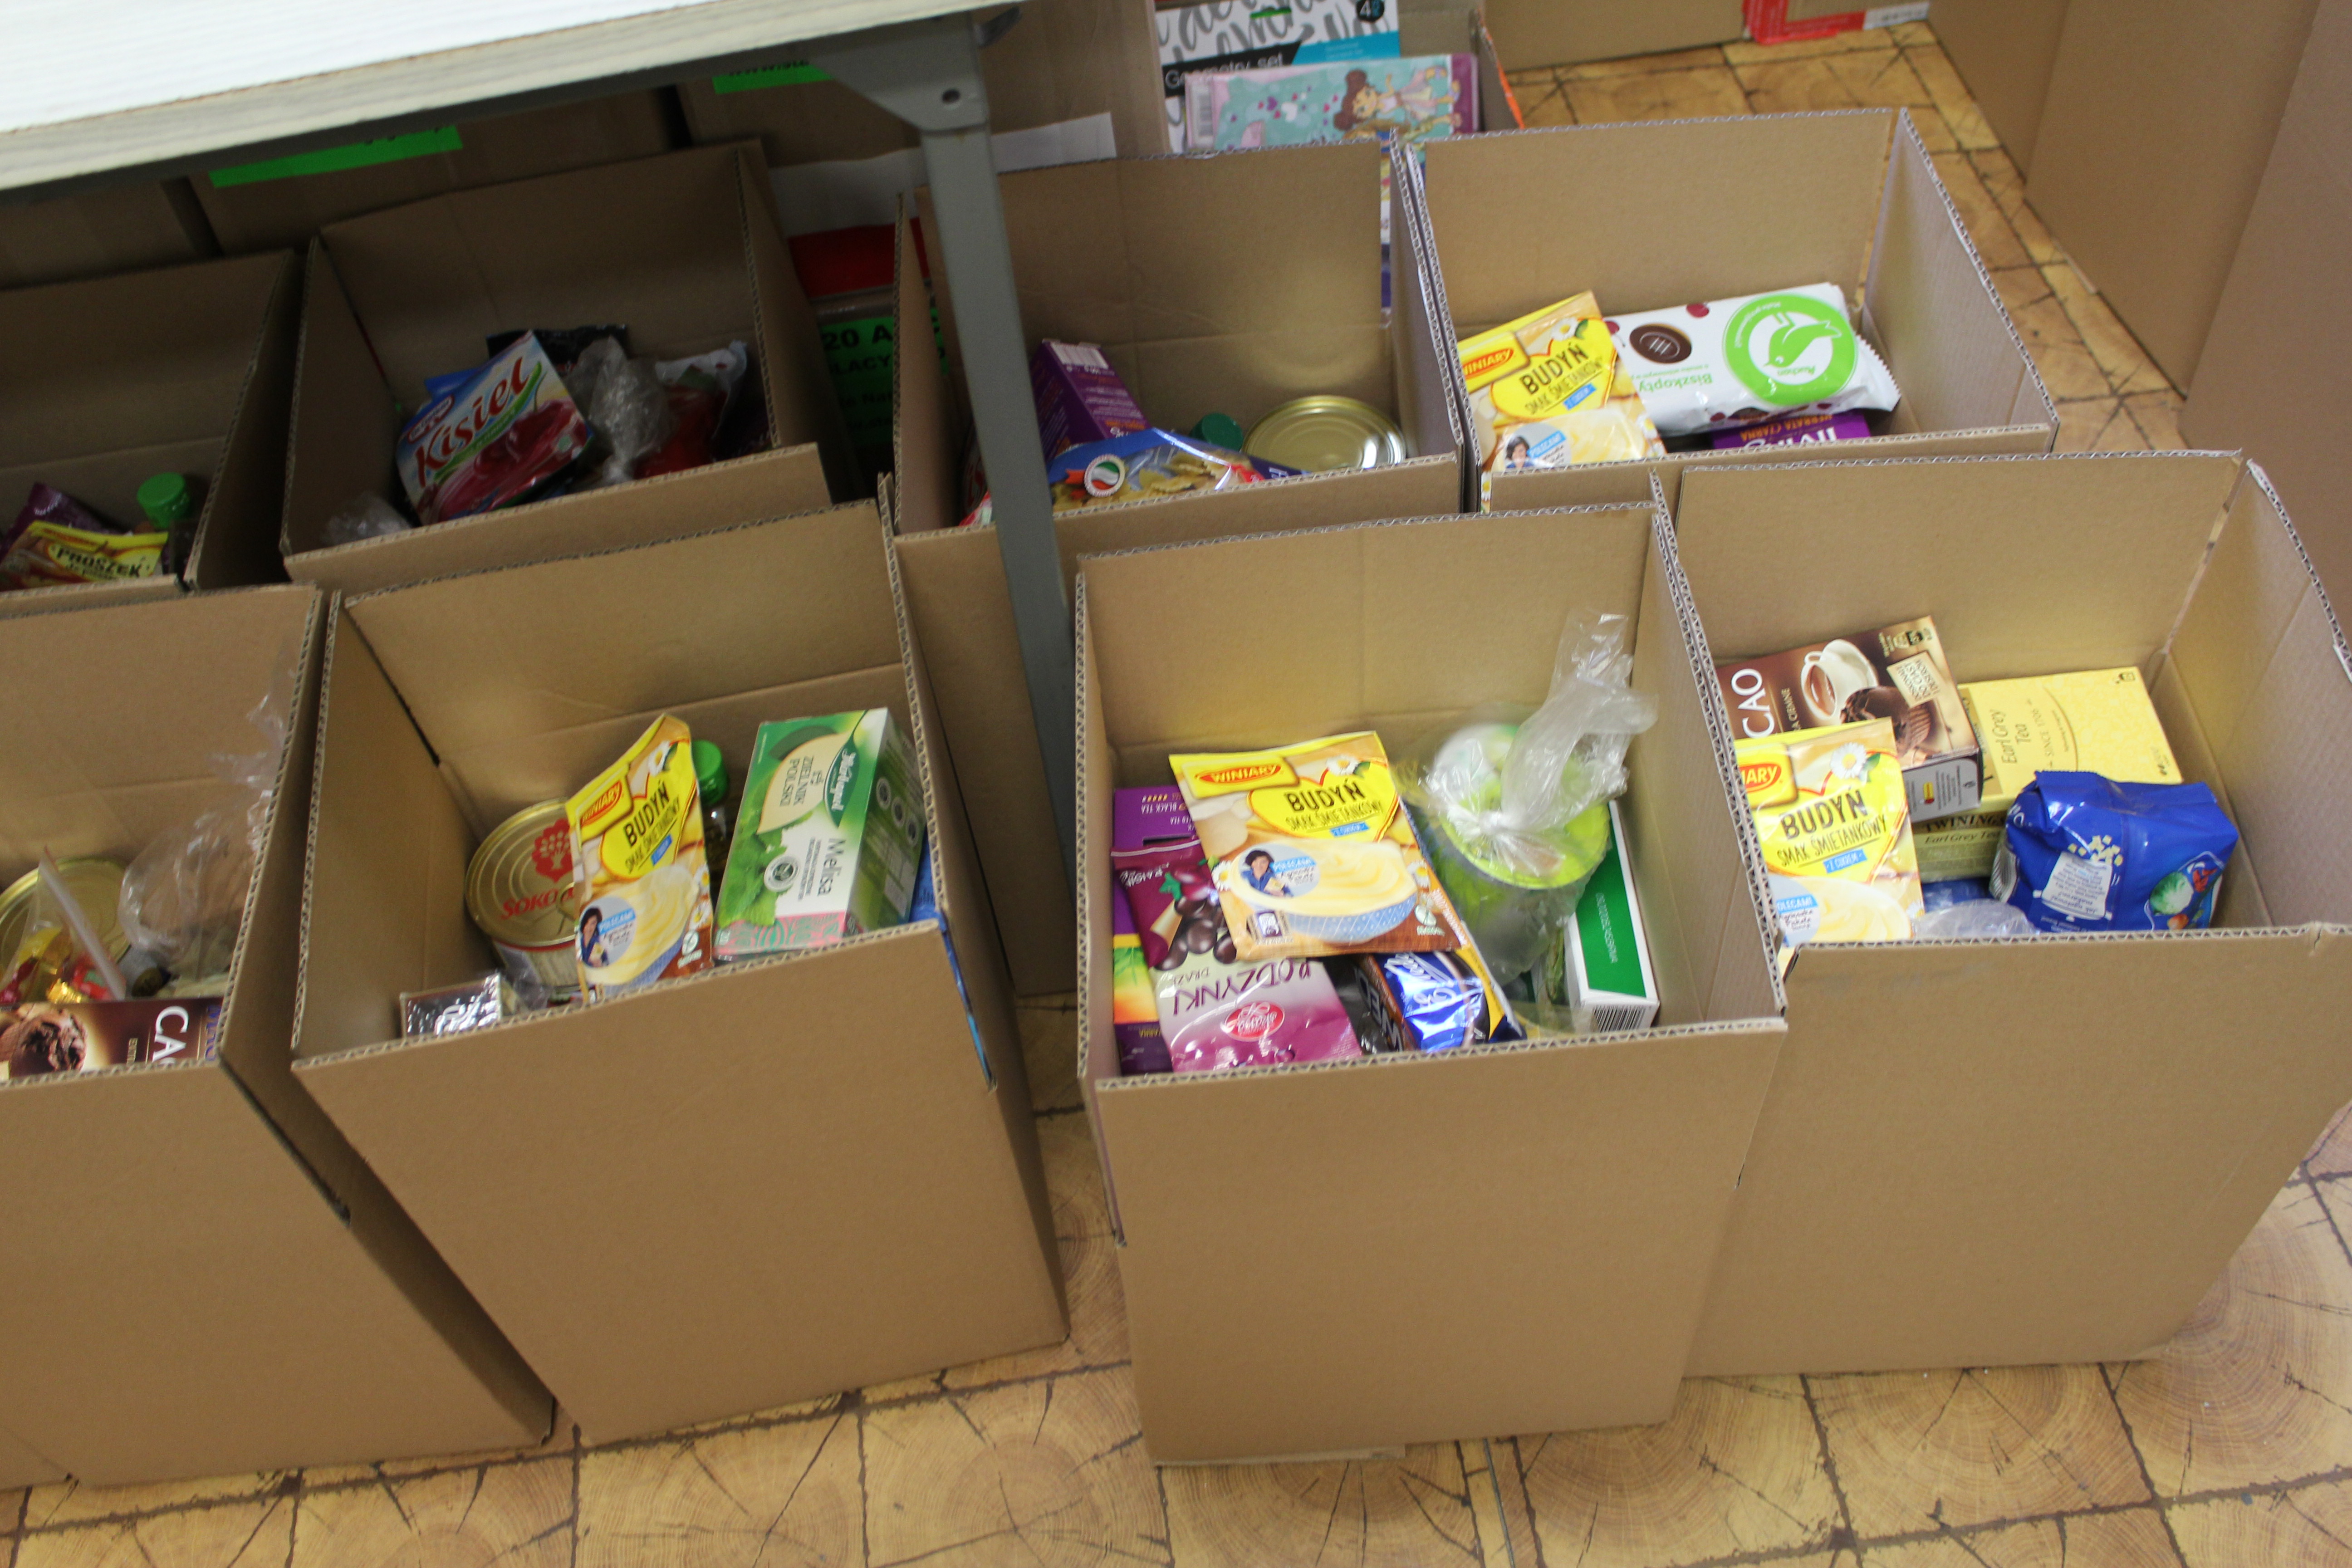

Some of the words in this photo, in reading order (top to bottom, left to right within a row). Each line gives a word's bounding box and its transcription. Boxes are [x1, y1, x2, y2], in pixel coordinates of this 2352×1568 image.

[1519, 342, 1587, 394] BUDYŃ
[1639, 373, 1713, 393] Biszkopty
[413, 358, 529, 488] Kisiel
[1989, 709, 2007, 735] Grey
[2014, 723, 2031, 746] Tea
[1996, 735, 2018, 765] Earl
[1211, 764, 1278, 784] WINIARY
[1141, 803, 1153, 814] TEA
[1284, 778, 1365, 812] BUDYŃ
[623, 781, 670, 848] BUDYŃ
[1779, 787, 1867, 840] BUDYŃ
[1776, 842, 1809, 867] SMAK
[1813, 813, 1886, 857] ŚMIETANKOWY
[817, 838, 846, 897] Melisa
